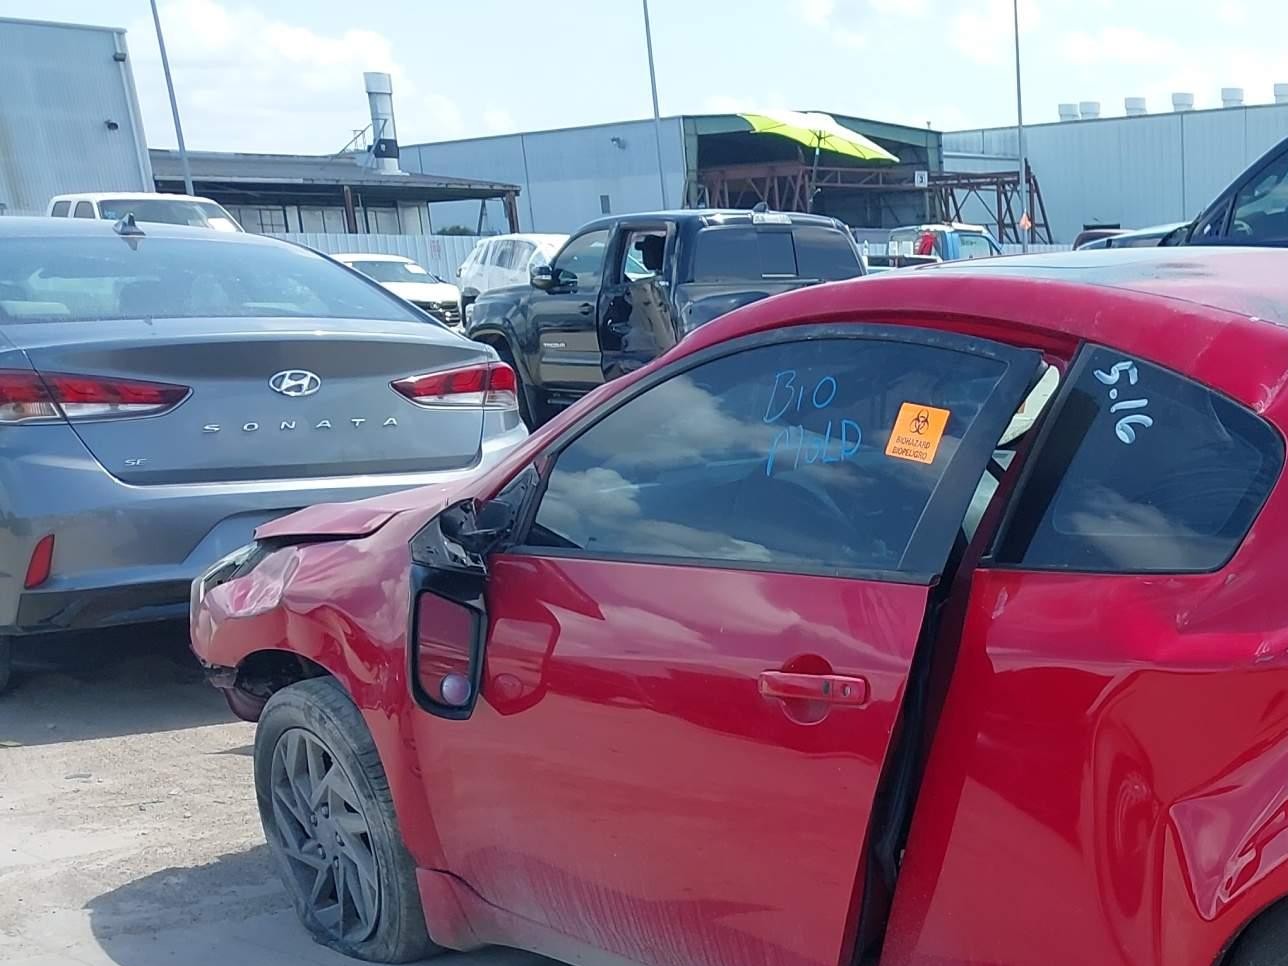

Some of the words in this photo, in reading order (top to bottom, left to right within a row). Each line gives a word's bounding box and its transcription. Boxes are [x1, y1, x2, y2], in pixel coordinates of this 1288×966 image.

[1094, 361, 1154, 444] 5.16
[203, 417, 397, 433] SONATA
[896, 435, 931, 449] BIOHAZARD
[124, 458, 147, 466] SE
